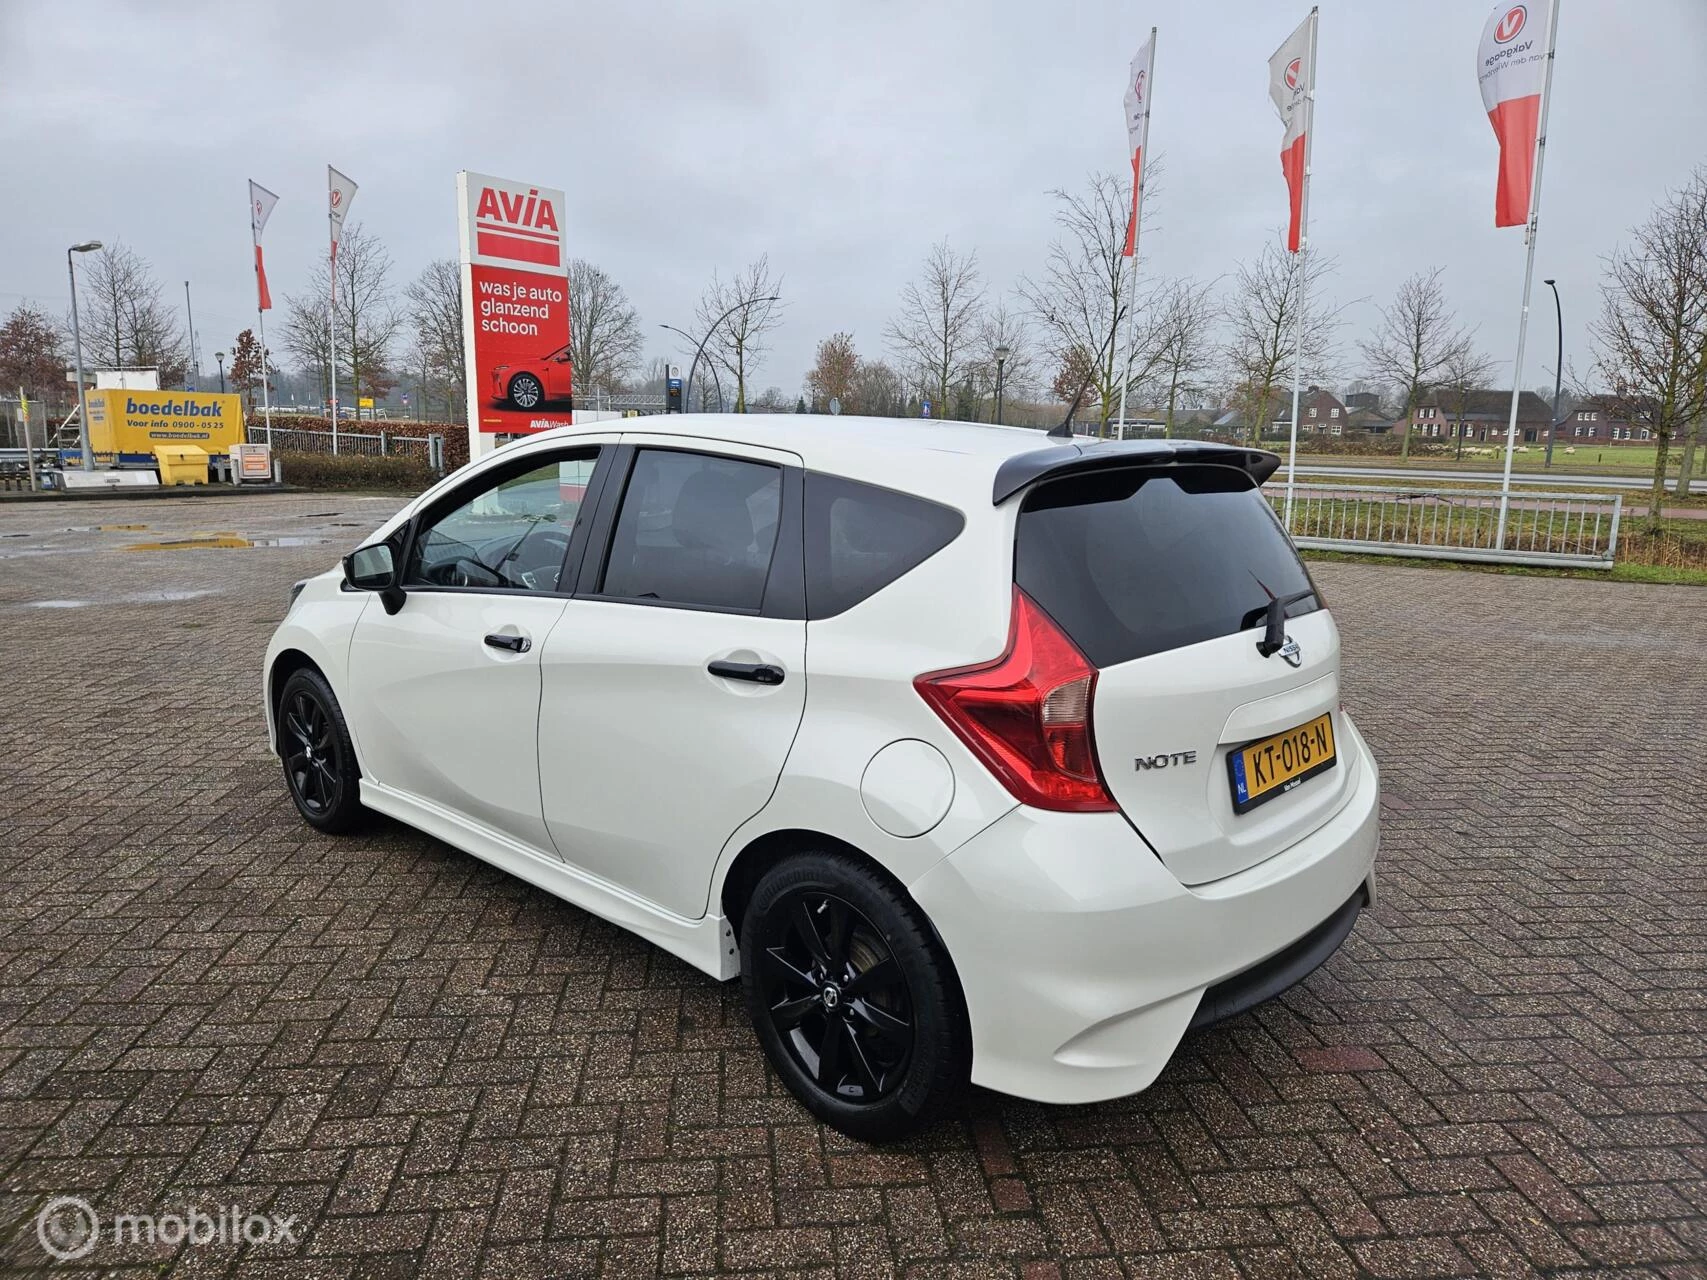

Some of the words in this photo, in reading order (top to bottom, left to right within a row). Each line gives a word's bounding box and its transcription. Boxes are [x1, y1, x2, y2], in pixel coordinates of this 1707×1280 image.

[480, 281, 510, 297] was
[512, 282, 526, 301] je
[529, 288, 562, 302] auto
[480, 298, 549, 319] glanzend
[482, 317, 538, 336] schoon
[126, 398, 222, 417] boedelbak
[127, 420, 148, 428] Voor
[151, 420, 168, 428] info
[172, 421, 194, 429] 0900
[1134, 750, 1196, 771] NOTE
[1253, 723, 1327, 788] KT-018-N
[1237, 781, 1247, 795] NL
